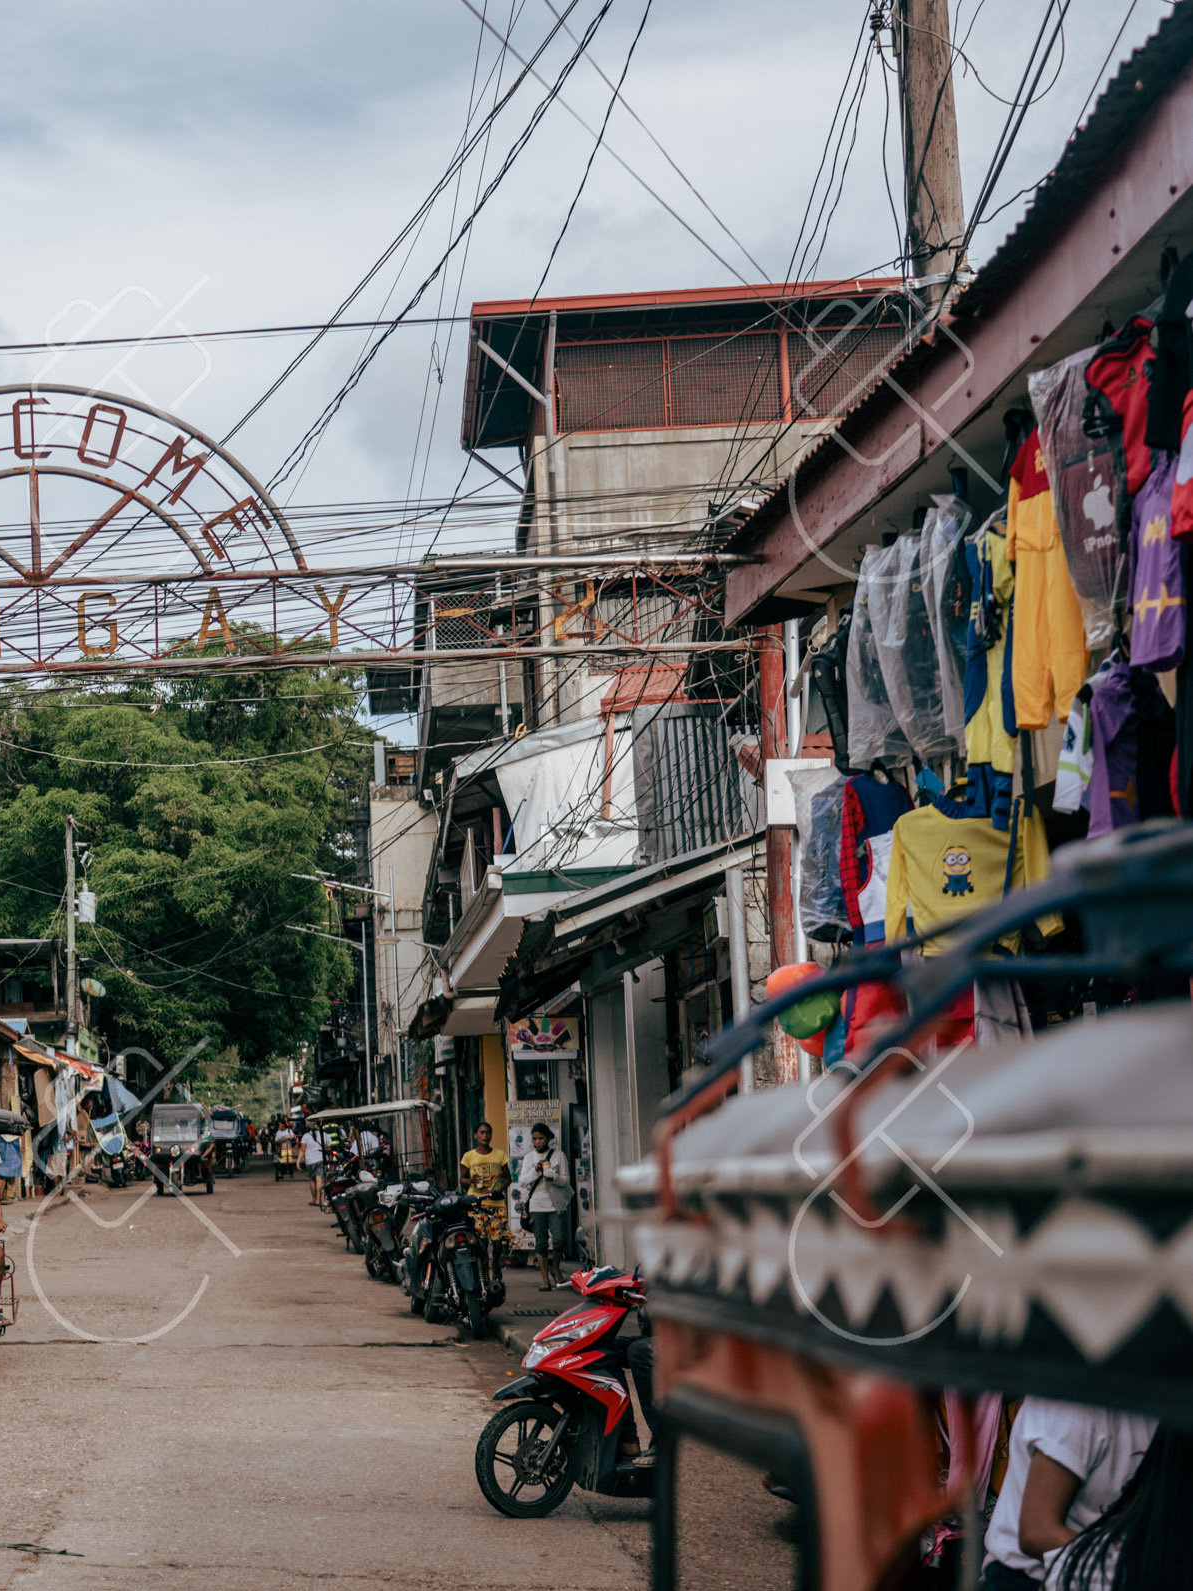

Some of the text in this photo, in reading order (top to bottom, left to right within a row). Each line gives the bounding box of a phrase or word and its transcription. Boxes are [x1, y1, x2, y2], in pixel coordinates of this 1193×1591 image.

[524, 1101, 560, 1109] SOUVENIR
[522, 1109, 553, 1118] CASHEW
[558, 1356, 583, 1368] HONDA
